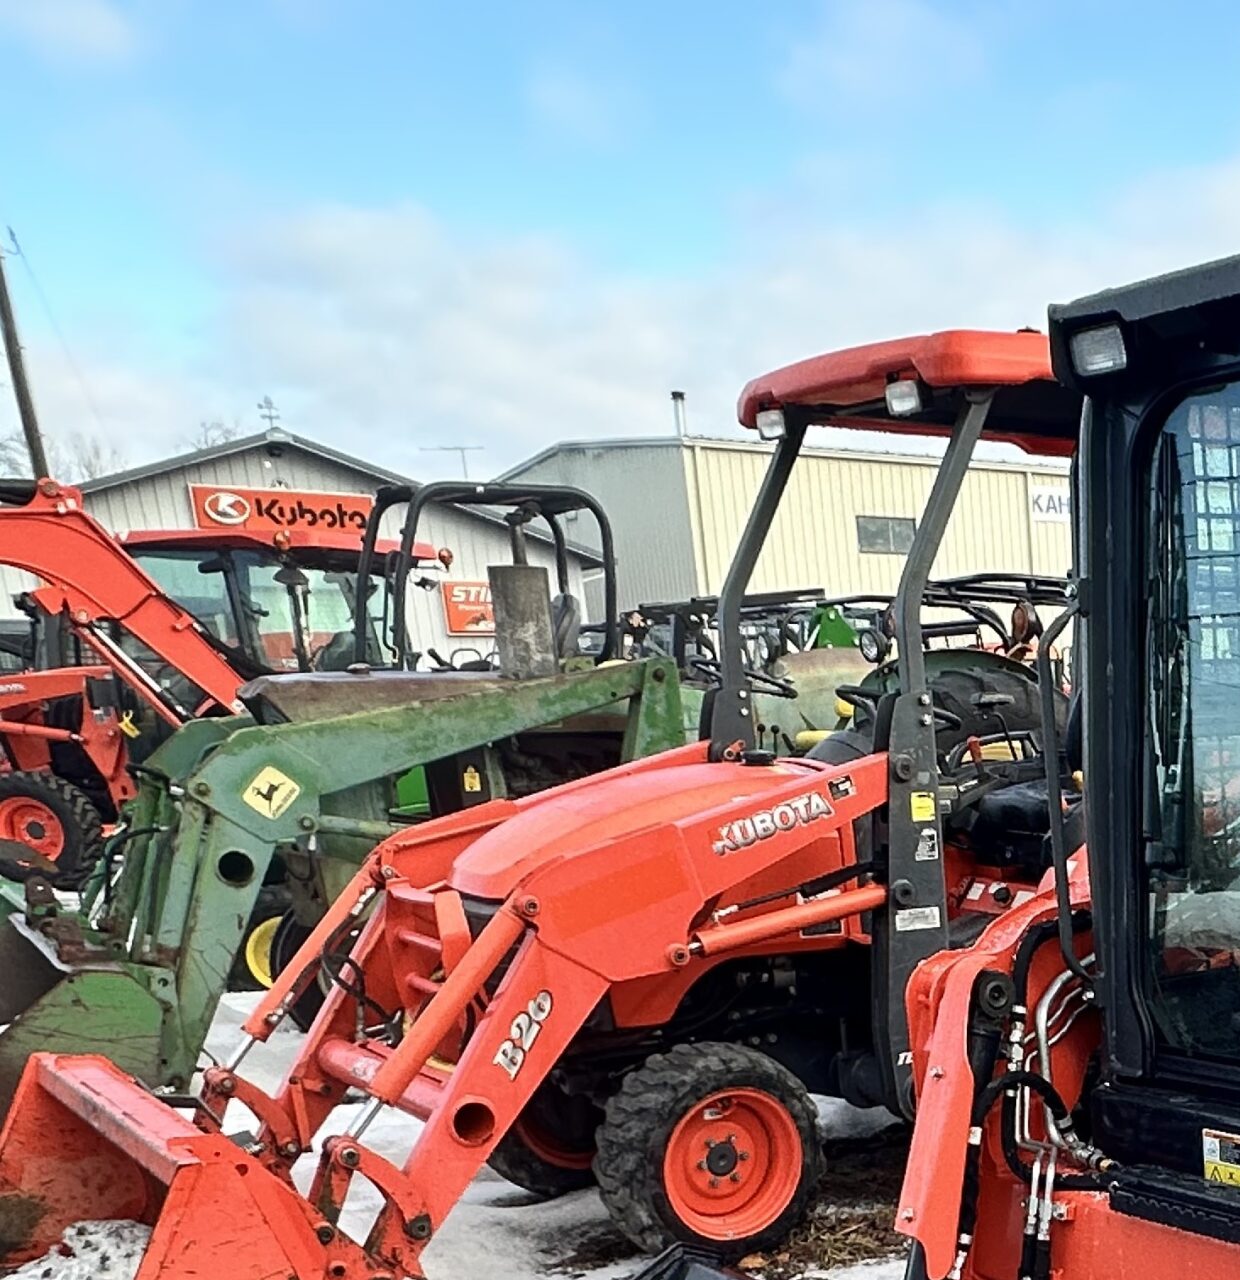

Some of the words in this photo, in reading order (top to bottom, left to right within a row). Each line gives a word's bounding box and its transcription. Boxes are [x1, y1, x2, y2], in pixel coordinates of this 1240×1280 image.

[255, 498, 366, 528] Kubota
[712, 791, 834, 856] KUBOTA
[492, 989, 553, 1081] B26
